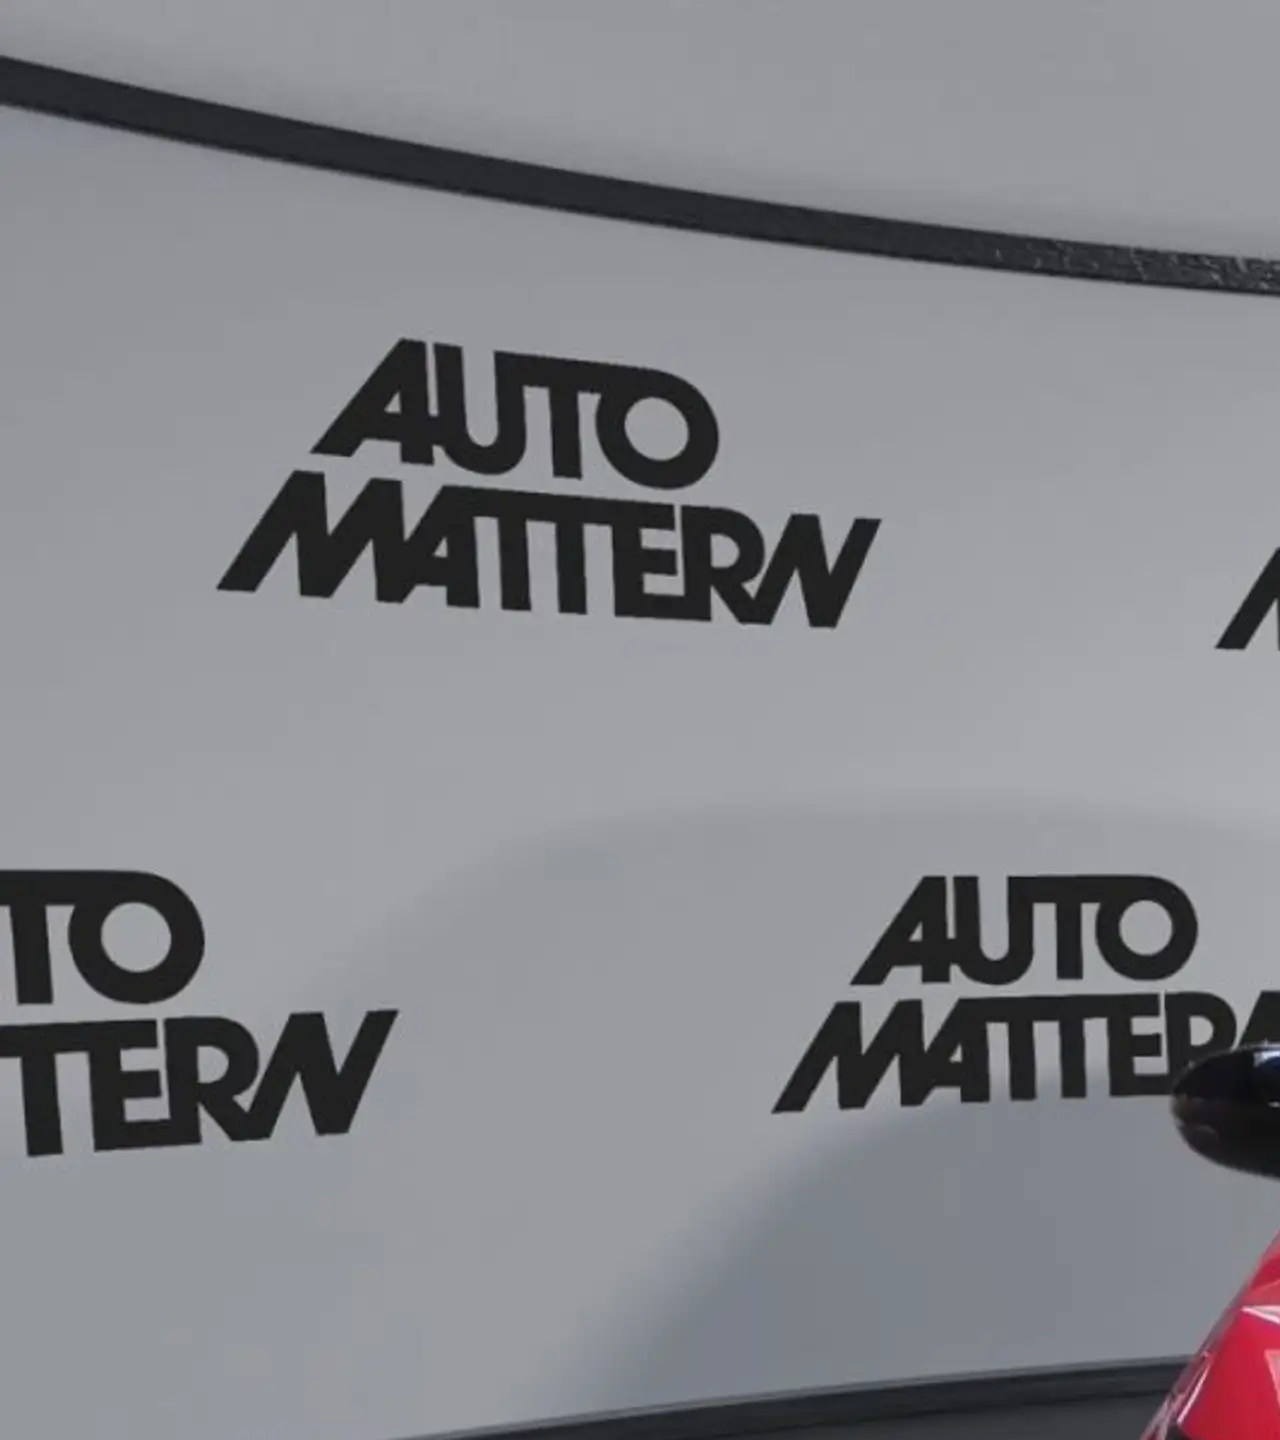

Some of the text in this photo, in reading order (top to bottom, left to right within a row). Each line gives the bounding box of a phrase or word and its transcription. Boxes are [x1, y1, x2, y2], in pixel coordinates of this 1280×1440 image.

[311, 338, 719, 490] AUTO
[217, 470, 881, 628] MATTERN
[851, 875, 1198, 985] AUTO
